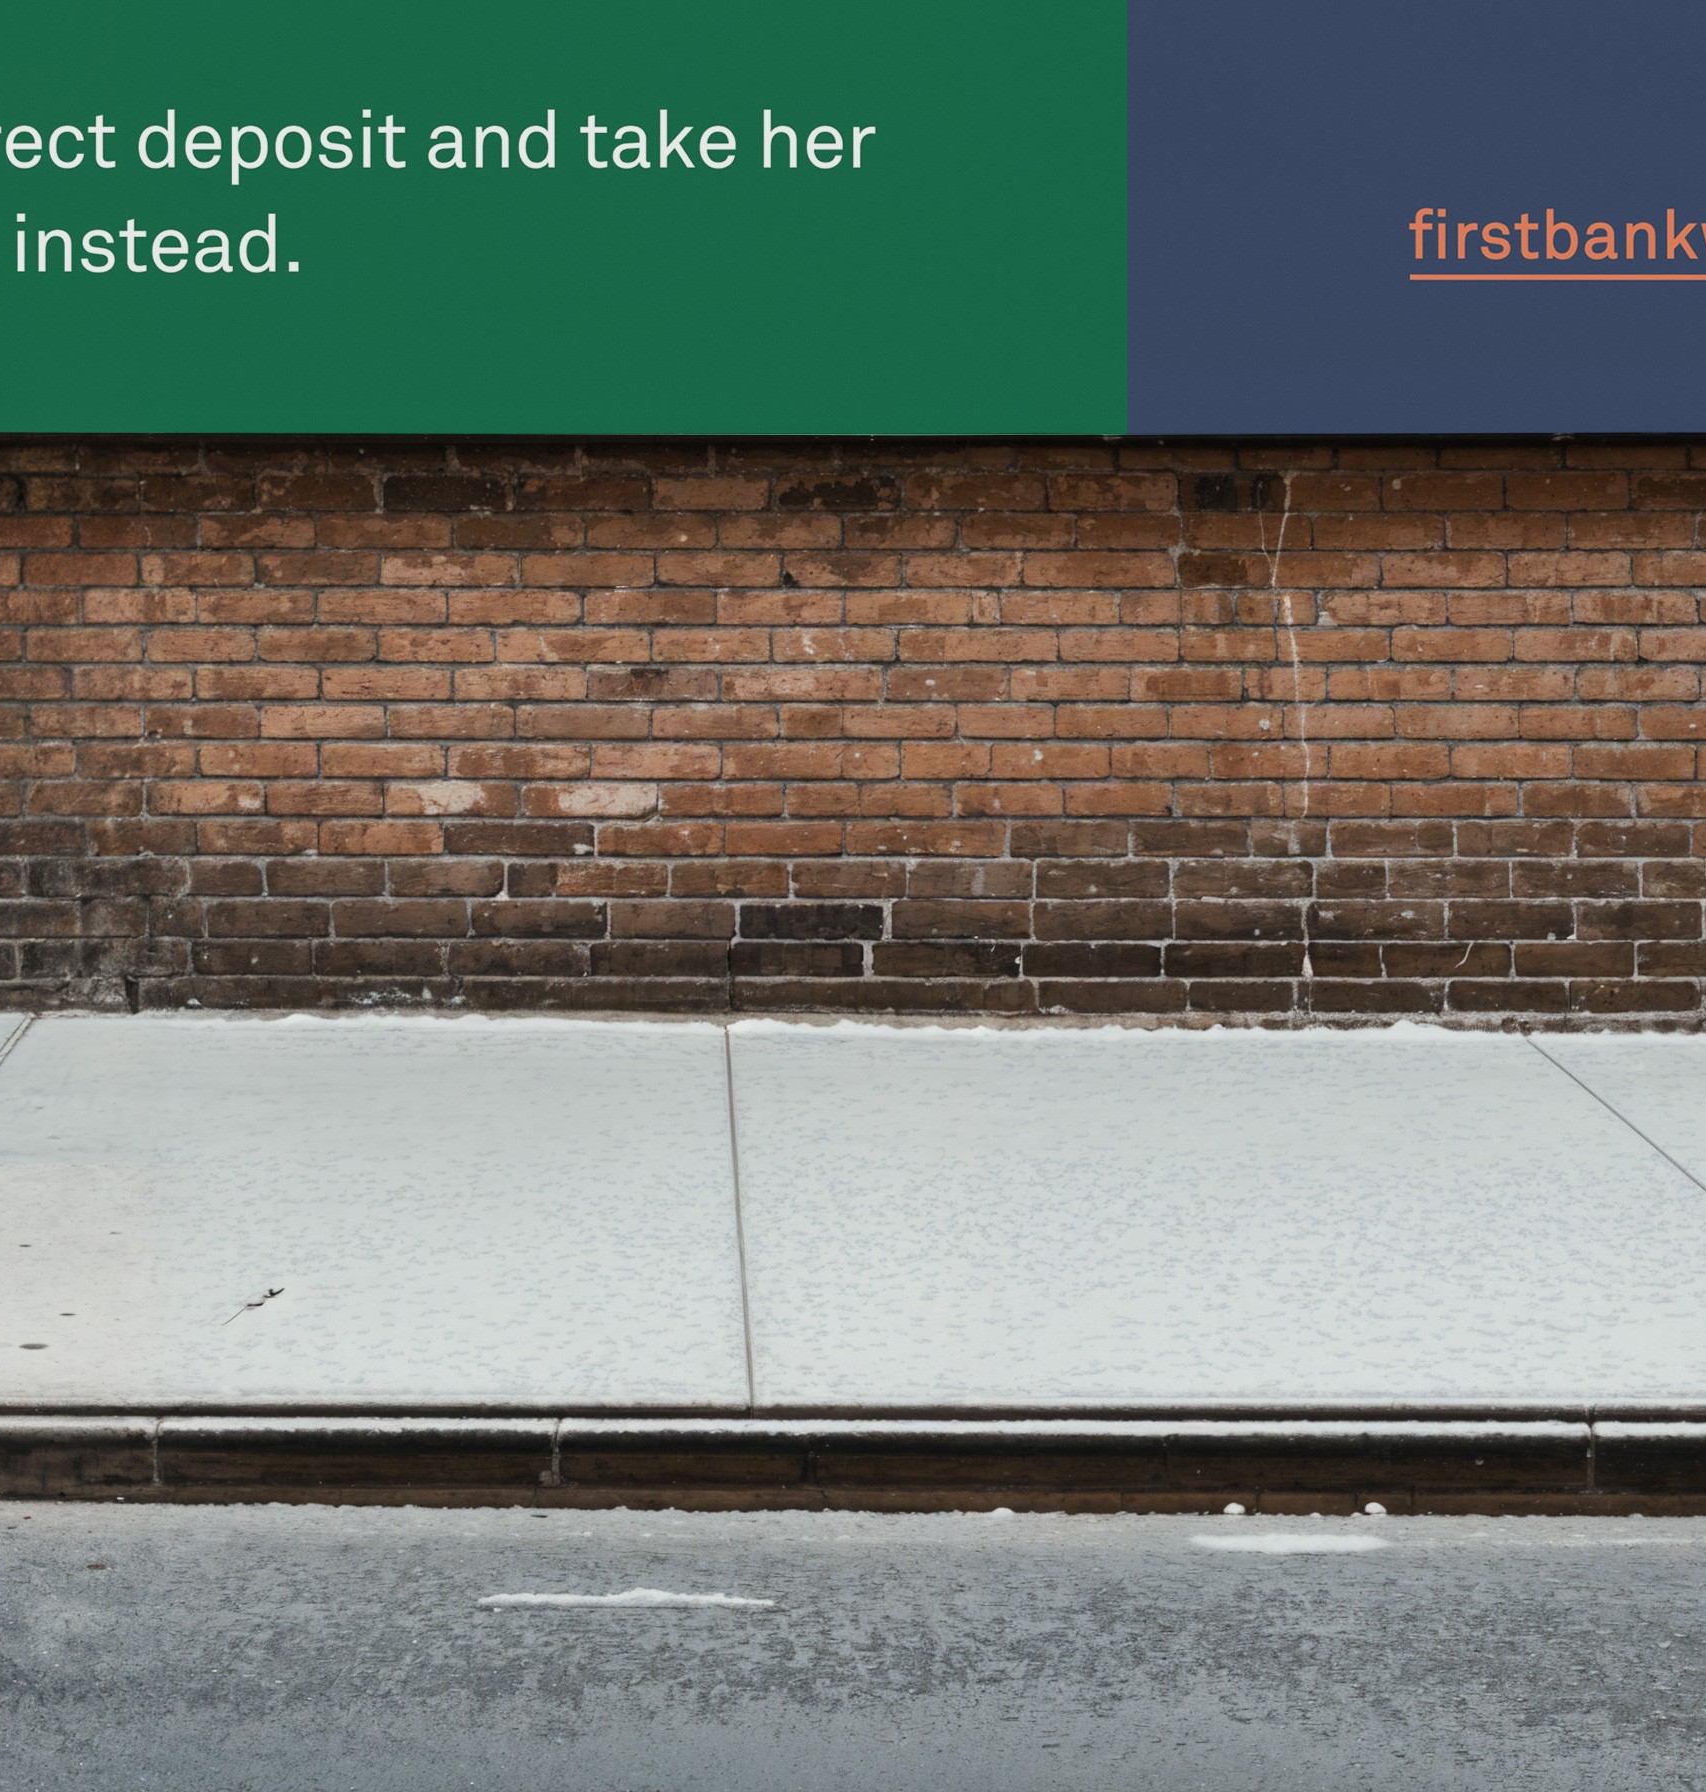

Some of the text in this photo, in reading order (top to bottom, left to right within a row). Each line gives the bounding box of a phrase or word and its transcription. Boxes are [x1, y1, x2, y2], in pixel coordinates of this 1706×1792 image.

[138, 109, 406, 185] deposit
[428, 109, 555, 169] and
[580, 109, 736, 169] take
[764, 109, 876, 169] her
[17, 213, 300, 273] instead.
